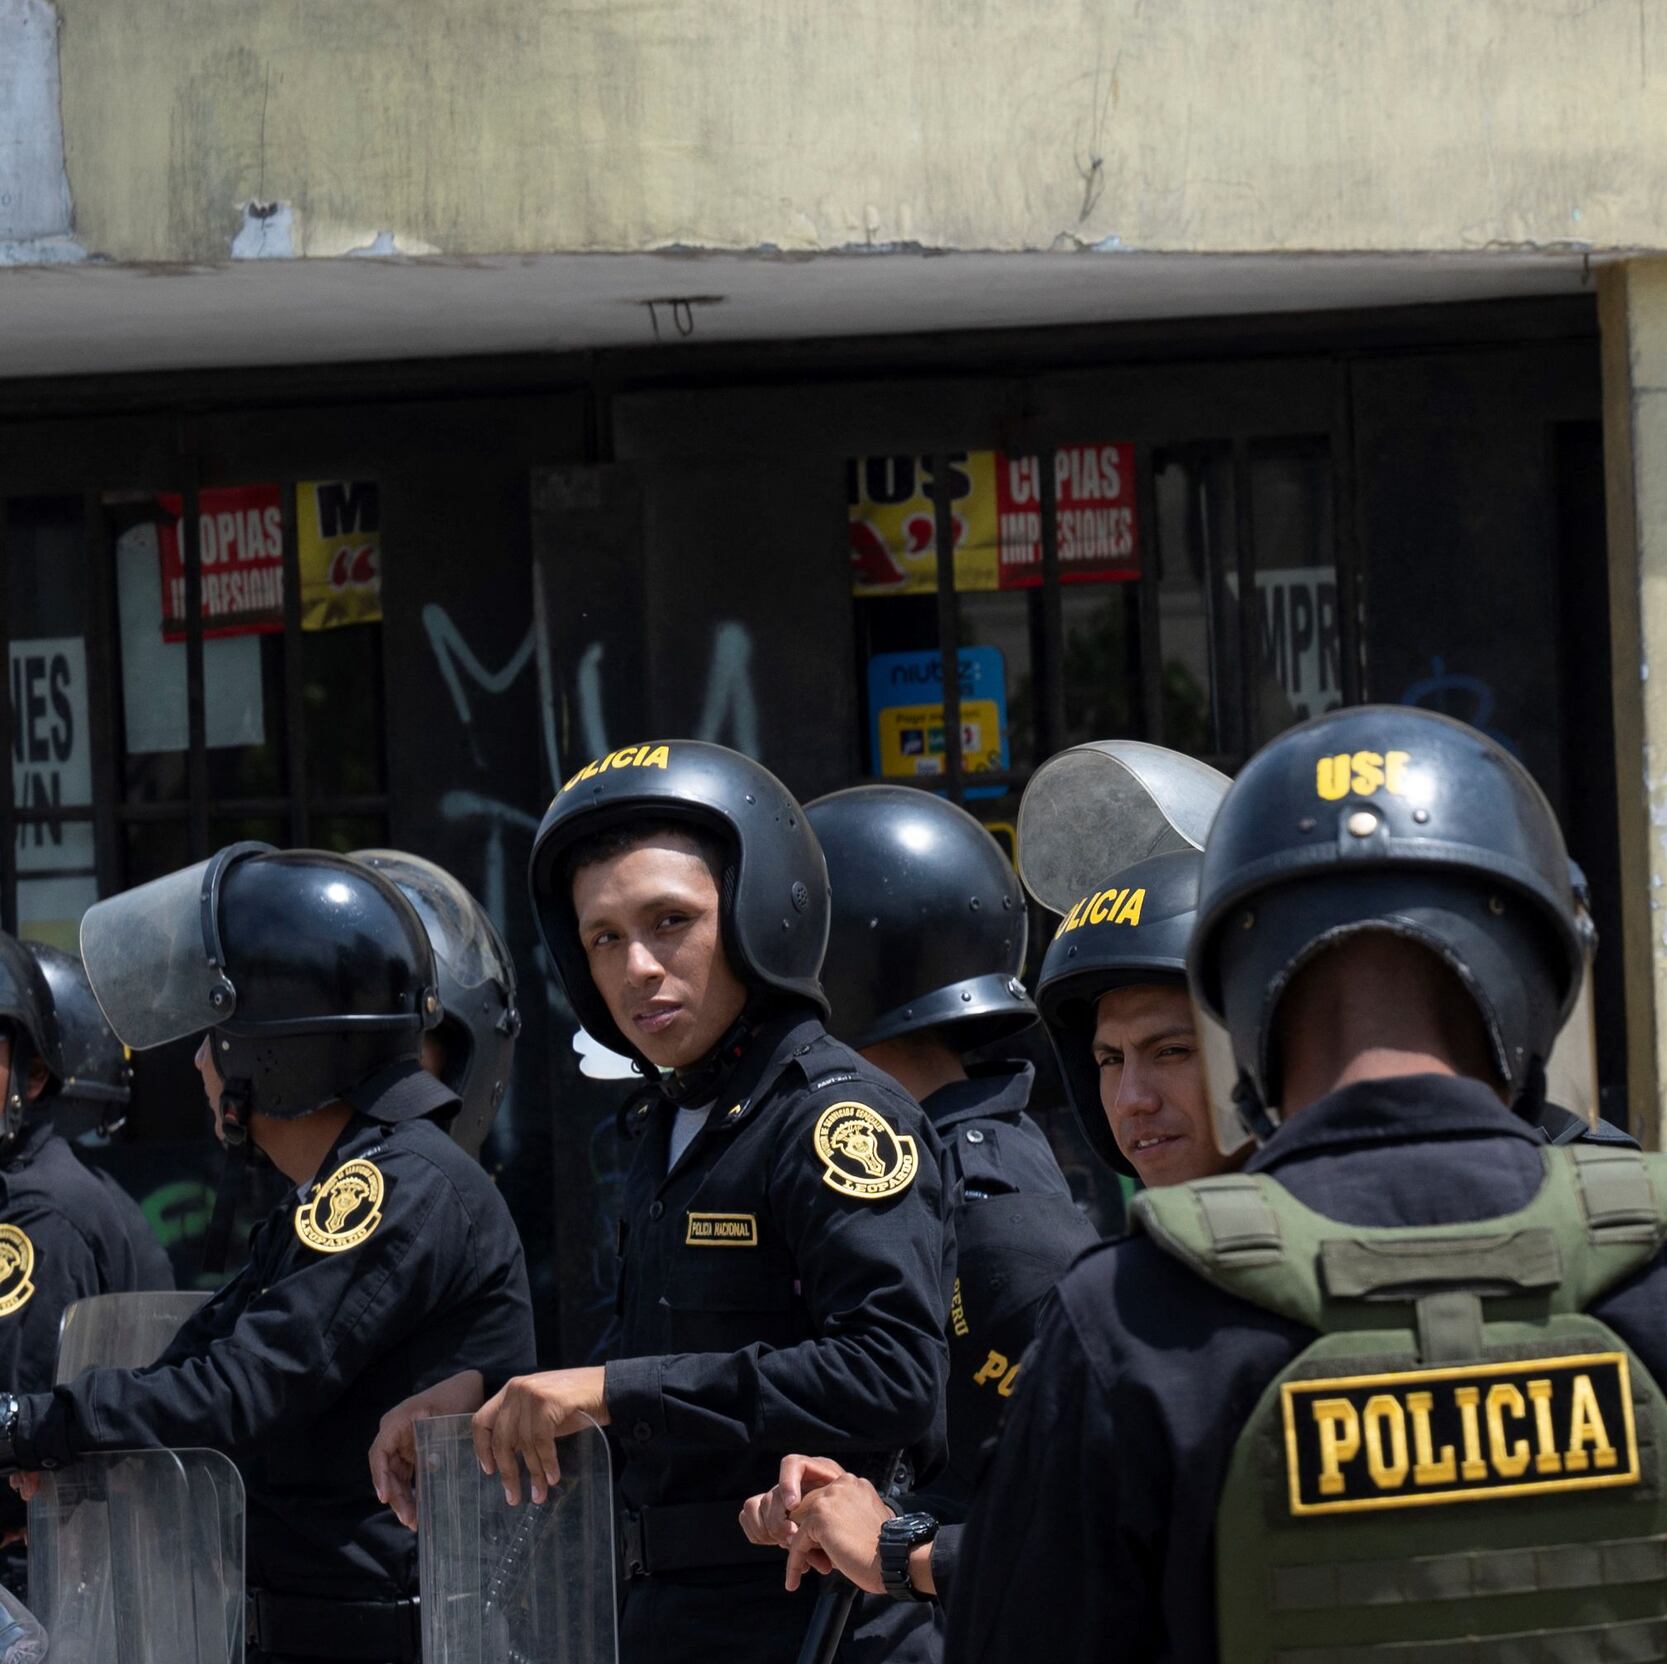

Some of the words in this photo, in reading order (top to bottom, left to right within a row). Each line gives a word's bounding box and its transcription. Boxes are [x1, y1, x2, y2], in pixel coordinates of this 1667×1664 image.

[1009, 447, 1121, 505] CPIAS
[1001, 516, 1133, 565] IMPESIONES
[843, 1154, 913, 1193] LEOPARDO
[301, 1218, 368, 1248] LEOPARDO
[1311, 1374, 1618, 1494] POLICIA
